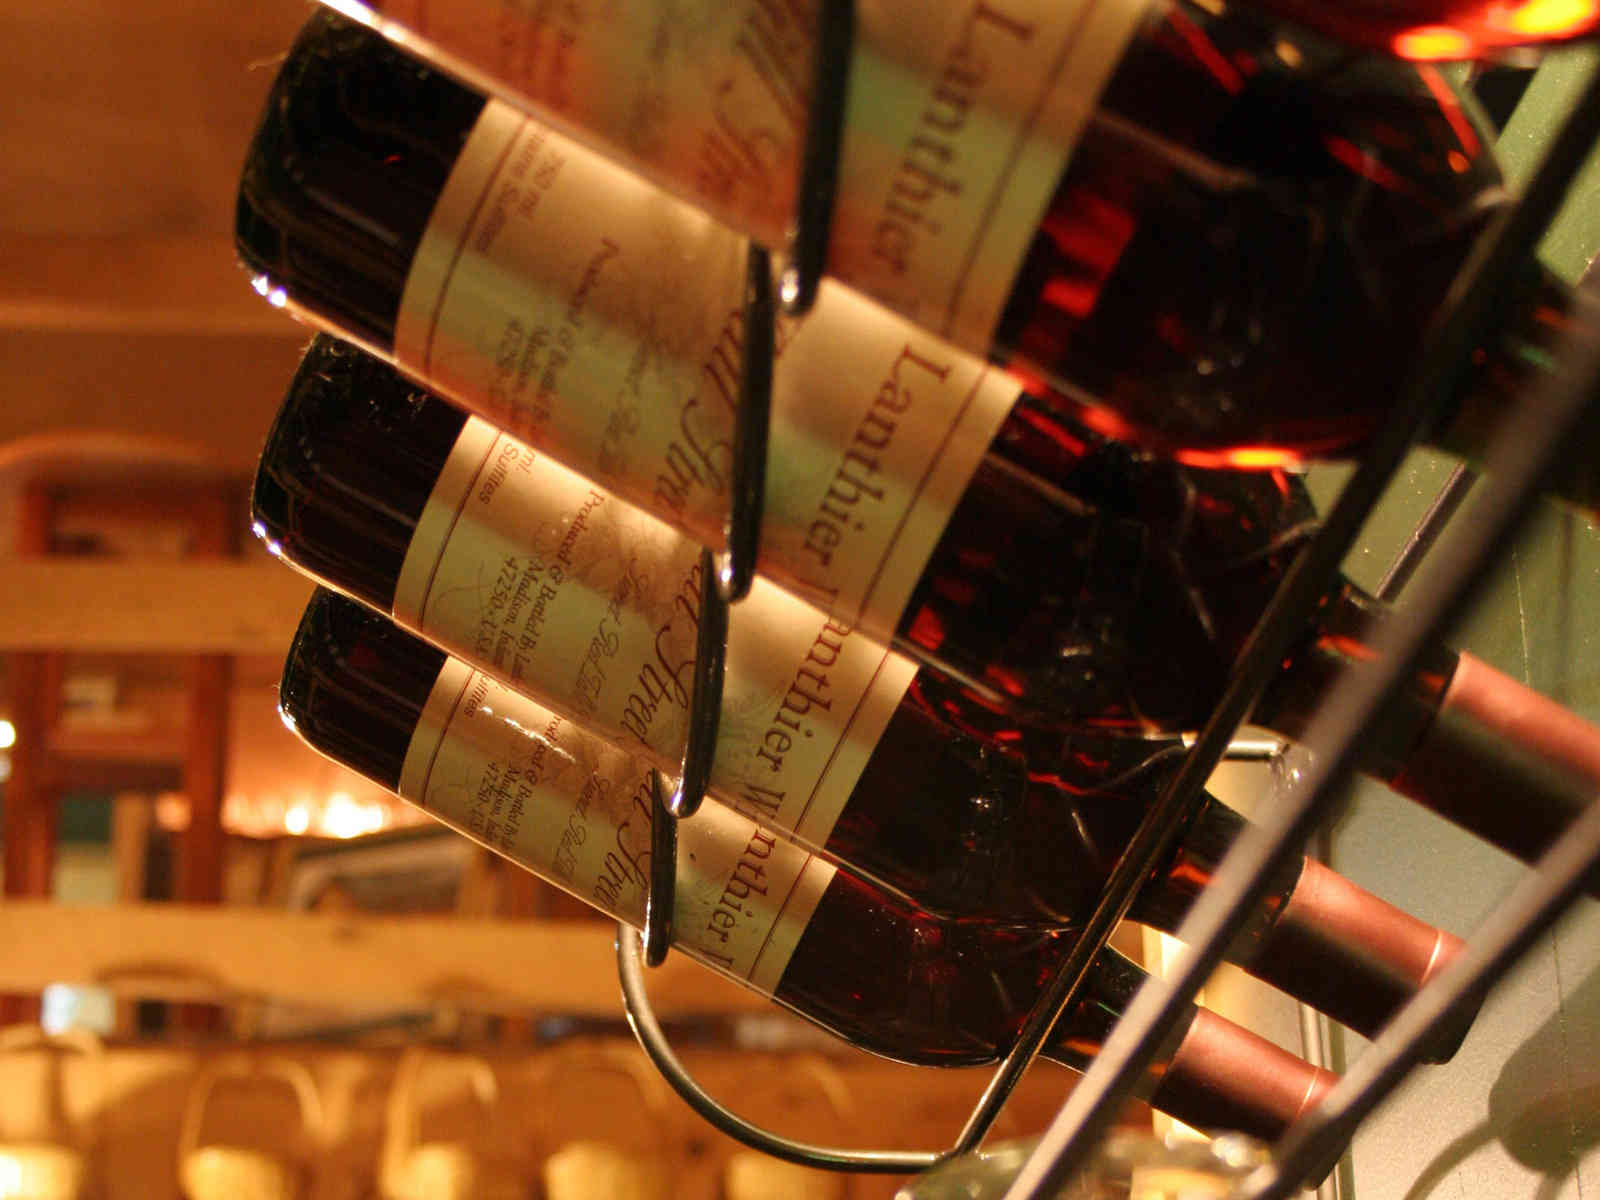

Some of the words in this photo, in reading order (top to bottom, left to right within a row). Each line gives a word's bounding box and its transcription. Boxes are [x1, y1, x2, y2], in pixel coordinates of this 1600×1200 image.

[867, 0, 1037, 280] Lanthier
[476, 442, 520, 506] Sulfites
[802, 343, 952, 569] Lanthier
[556, 489, 604, 565] Produced
[488, 555, 521, 610] 47250
[546, 564, 565, 586] &
[523, 584, 556, 641] Bottled
[462, 674, 490, 719] ulfites
[619, 626, 695, 748] Street
[755, 614, 853, 773] anthier
[506, 783, 533, 827] Bottled
[523, 768, 541, 786] &
